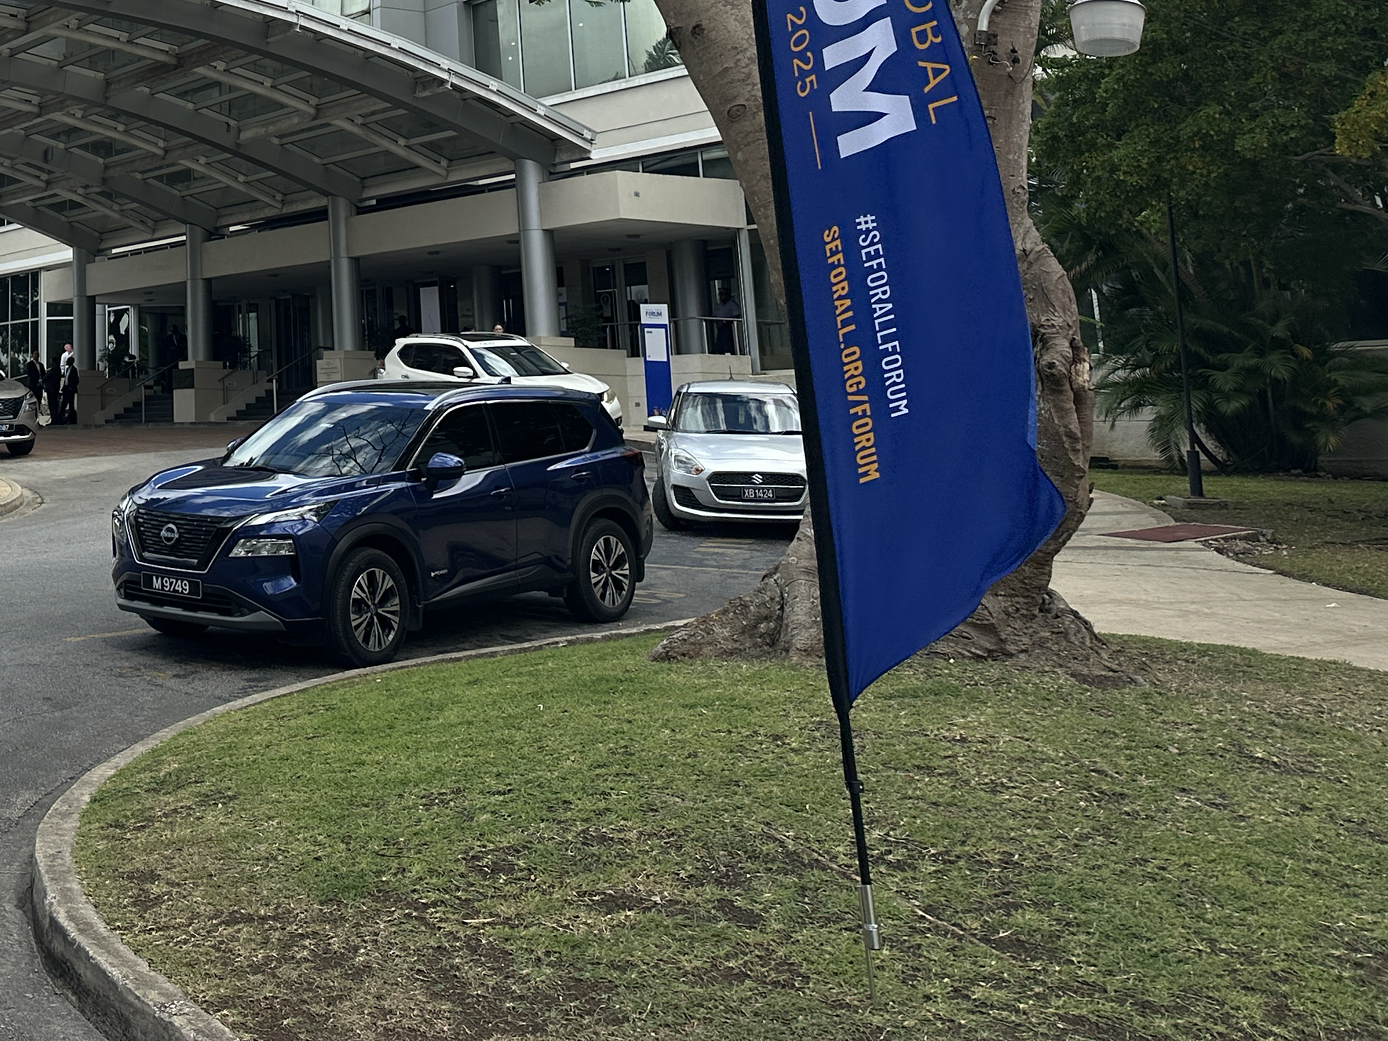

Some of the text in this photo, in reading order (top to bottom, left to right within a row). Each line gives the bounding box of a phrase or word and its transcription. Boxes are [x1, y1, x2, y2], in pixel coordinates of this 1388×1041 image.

[785, 5, 818, 99] 2025
[823, 225, 881, 484] SEFORALL.ORG/FORUM
[855, 213, 909, 418] #SEFORALLFORUM
[755, 489, 773, 498] 1424
[152, 575, 190, 594] M 9749
